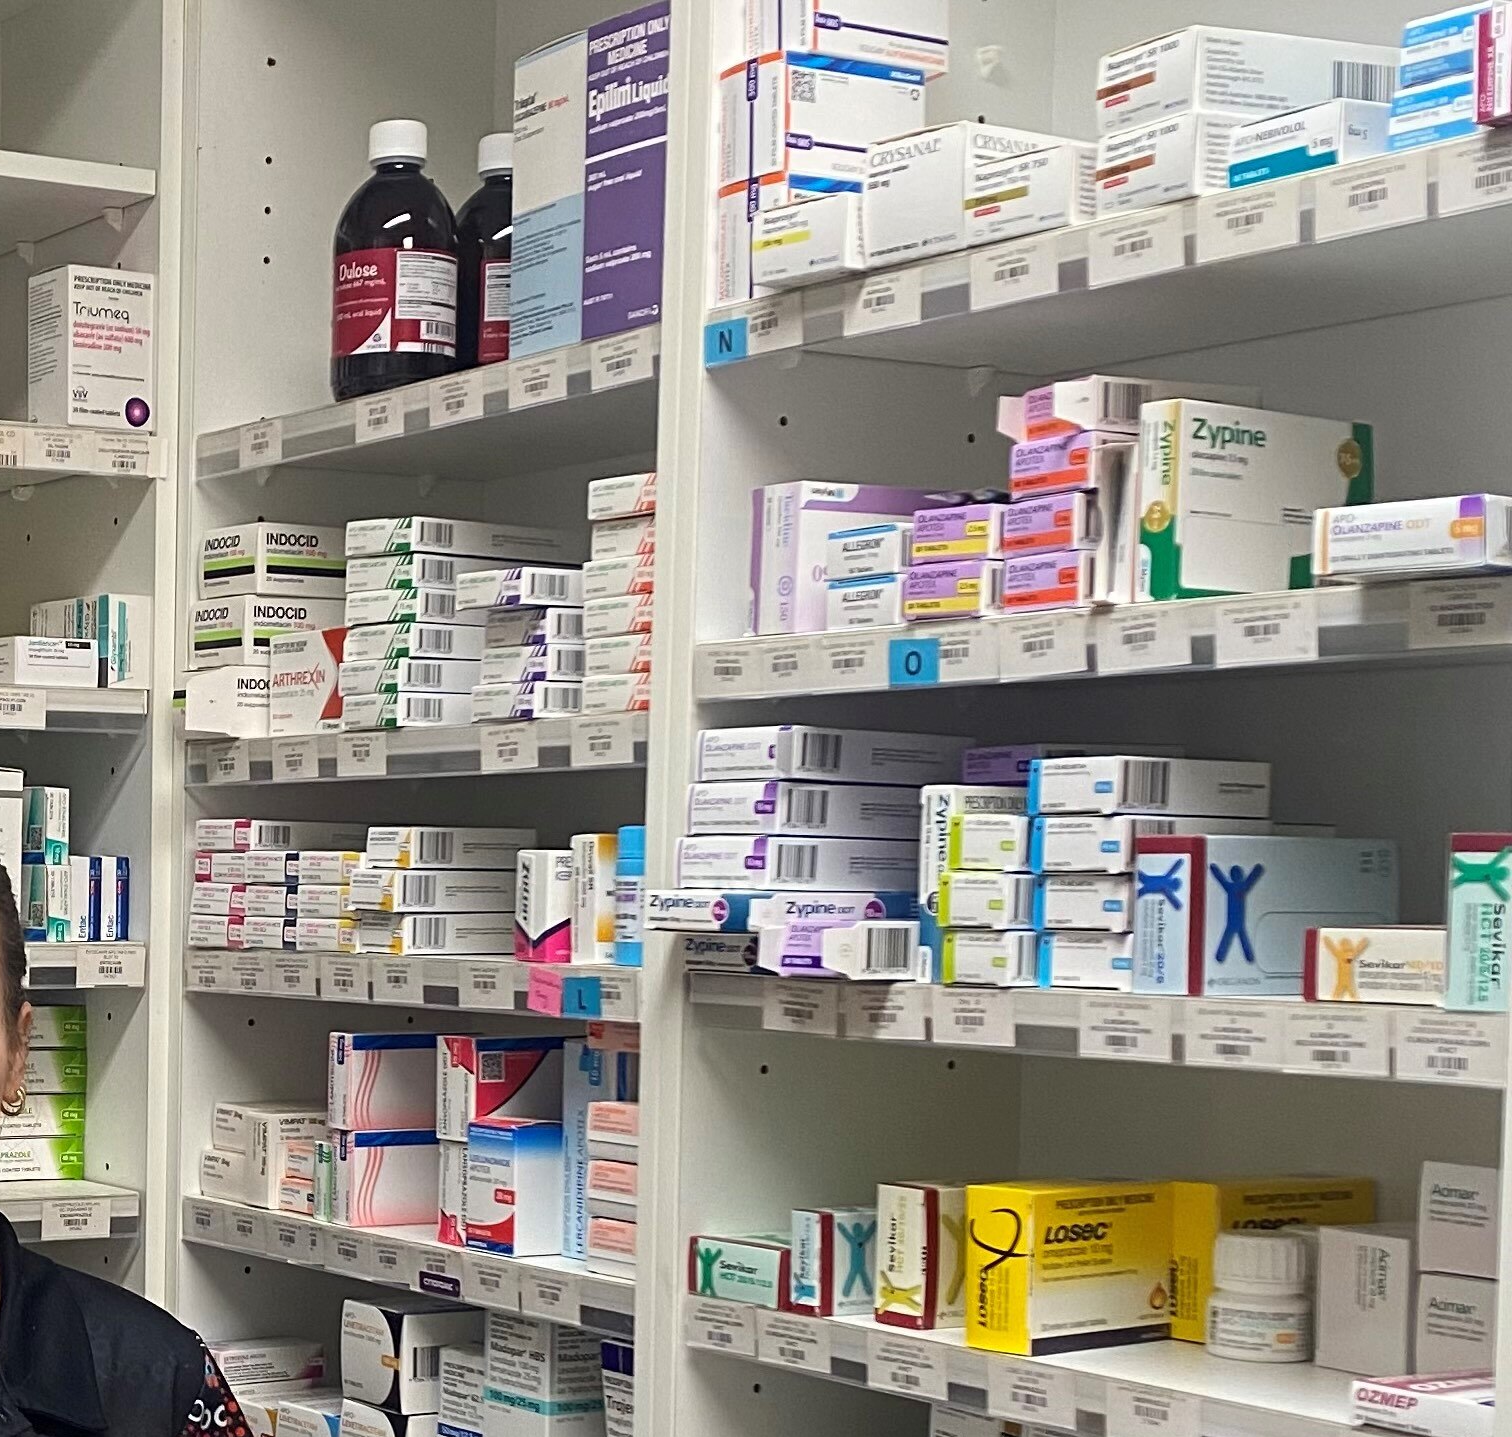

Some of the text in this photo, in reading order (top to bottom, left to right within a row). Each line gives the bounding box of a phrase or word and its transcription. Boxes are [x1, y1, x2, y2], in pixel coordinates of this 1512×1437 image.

[606, 38, 649, 66] MEDICINE
[588, 77, 632, 121] Epilim
[869, 138, 942, 169] CRYSANAL
[338, 261, 379, 281] Dulose
[72, 300, 130, 325] Triumeq
[718, 330, 734, 354] N
[1191, 416, 1268, 450] Zypine
[1159, 420, 1177, 487] Zypine
[203, 534, 241, 553] INDOCID
[265, 532, 319, 549] INDOCID
[194, 605, 230, 624] INDOCID
[252, 605, 308, 620] INDOCID
[271, 662, 327, 690] ARTHREXIN
[648, 894, 695, 913] Zypine
[784, 900, 838, 918] Zypine
[1358, 958, 1406, 973] Sevikar
[576, 988, 588, 1011] L
[1430, 1182, 1480, 1201] Acimax
[1042, 1219, 1110, 1246] LOSEC
[718, 1259, 759, 1276] Sevikar
[1428, 1296, 1477, 1316] Acimax
[1355, 1387, 1419, 1409] OZMEP
